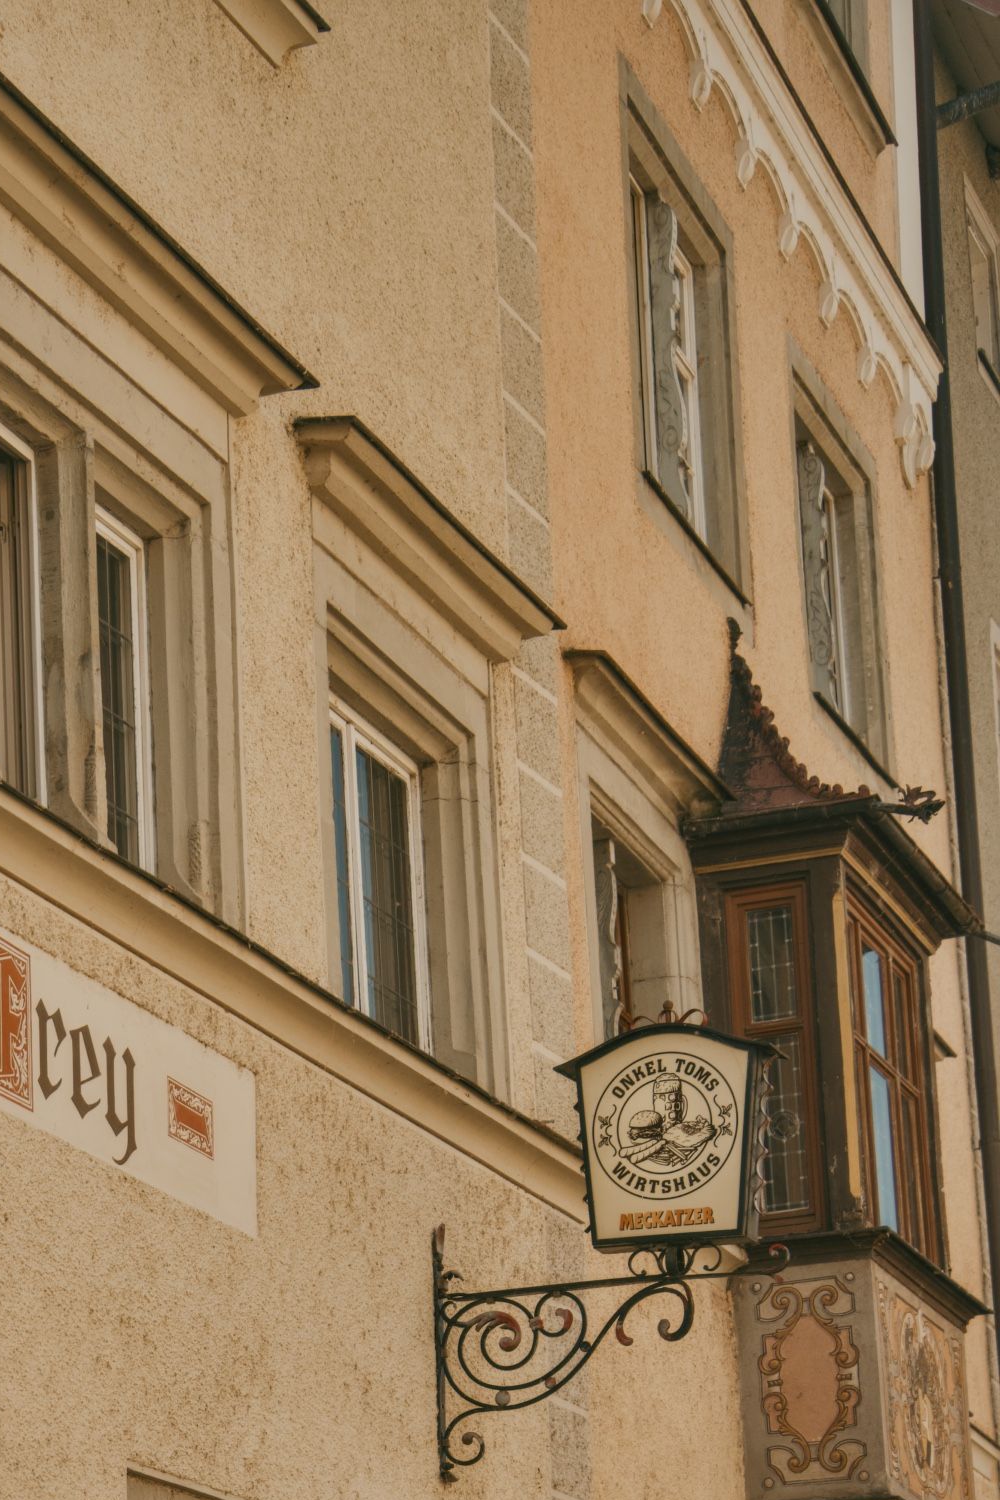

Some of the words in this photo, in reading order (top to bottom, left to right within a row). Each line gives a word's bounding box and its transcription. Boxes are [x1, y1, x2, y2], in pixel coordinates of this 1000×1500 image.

[611, 1058, 667, 1099] ONKEL
[675, 1058, 720, 1092] TOMS
[612, 1152, 721, 1194] WIRTSHAUS
[619, 1206, 715, 1231] MECKATZER
